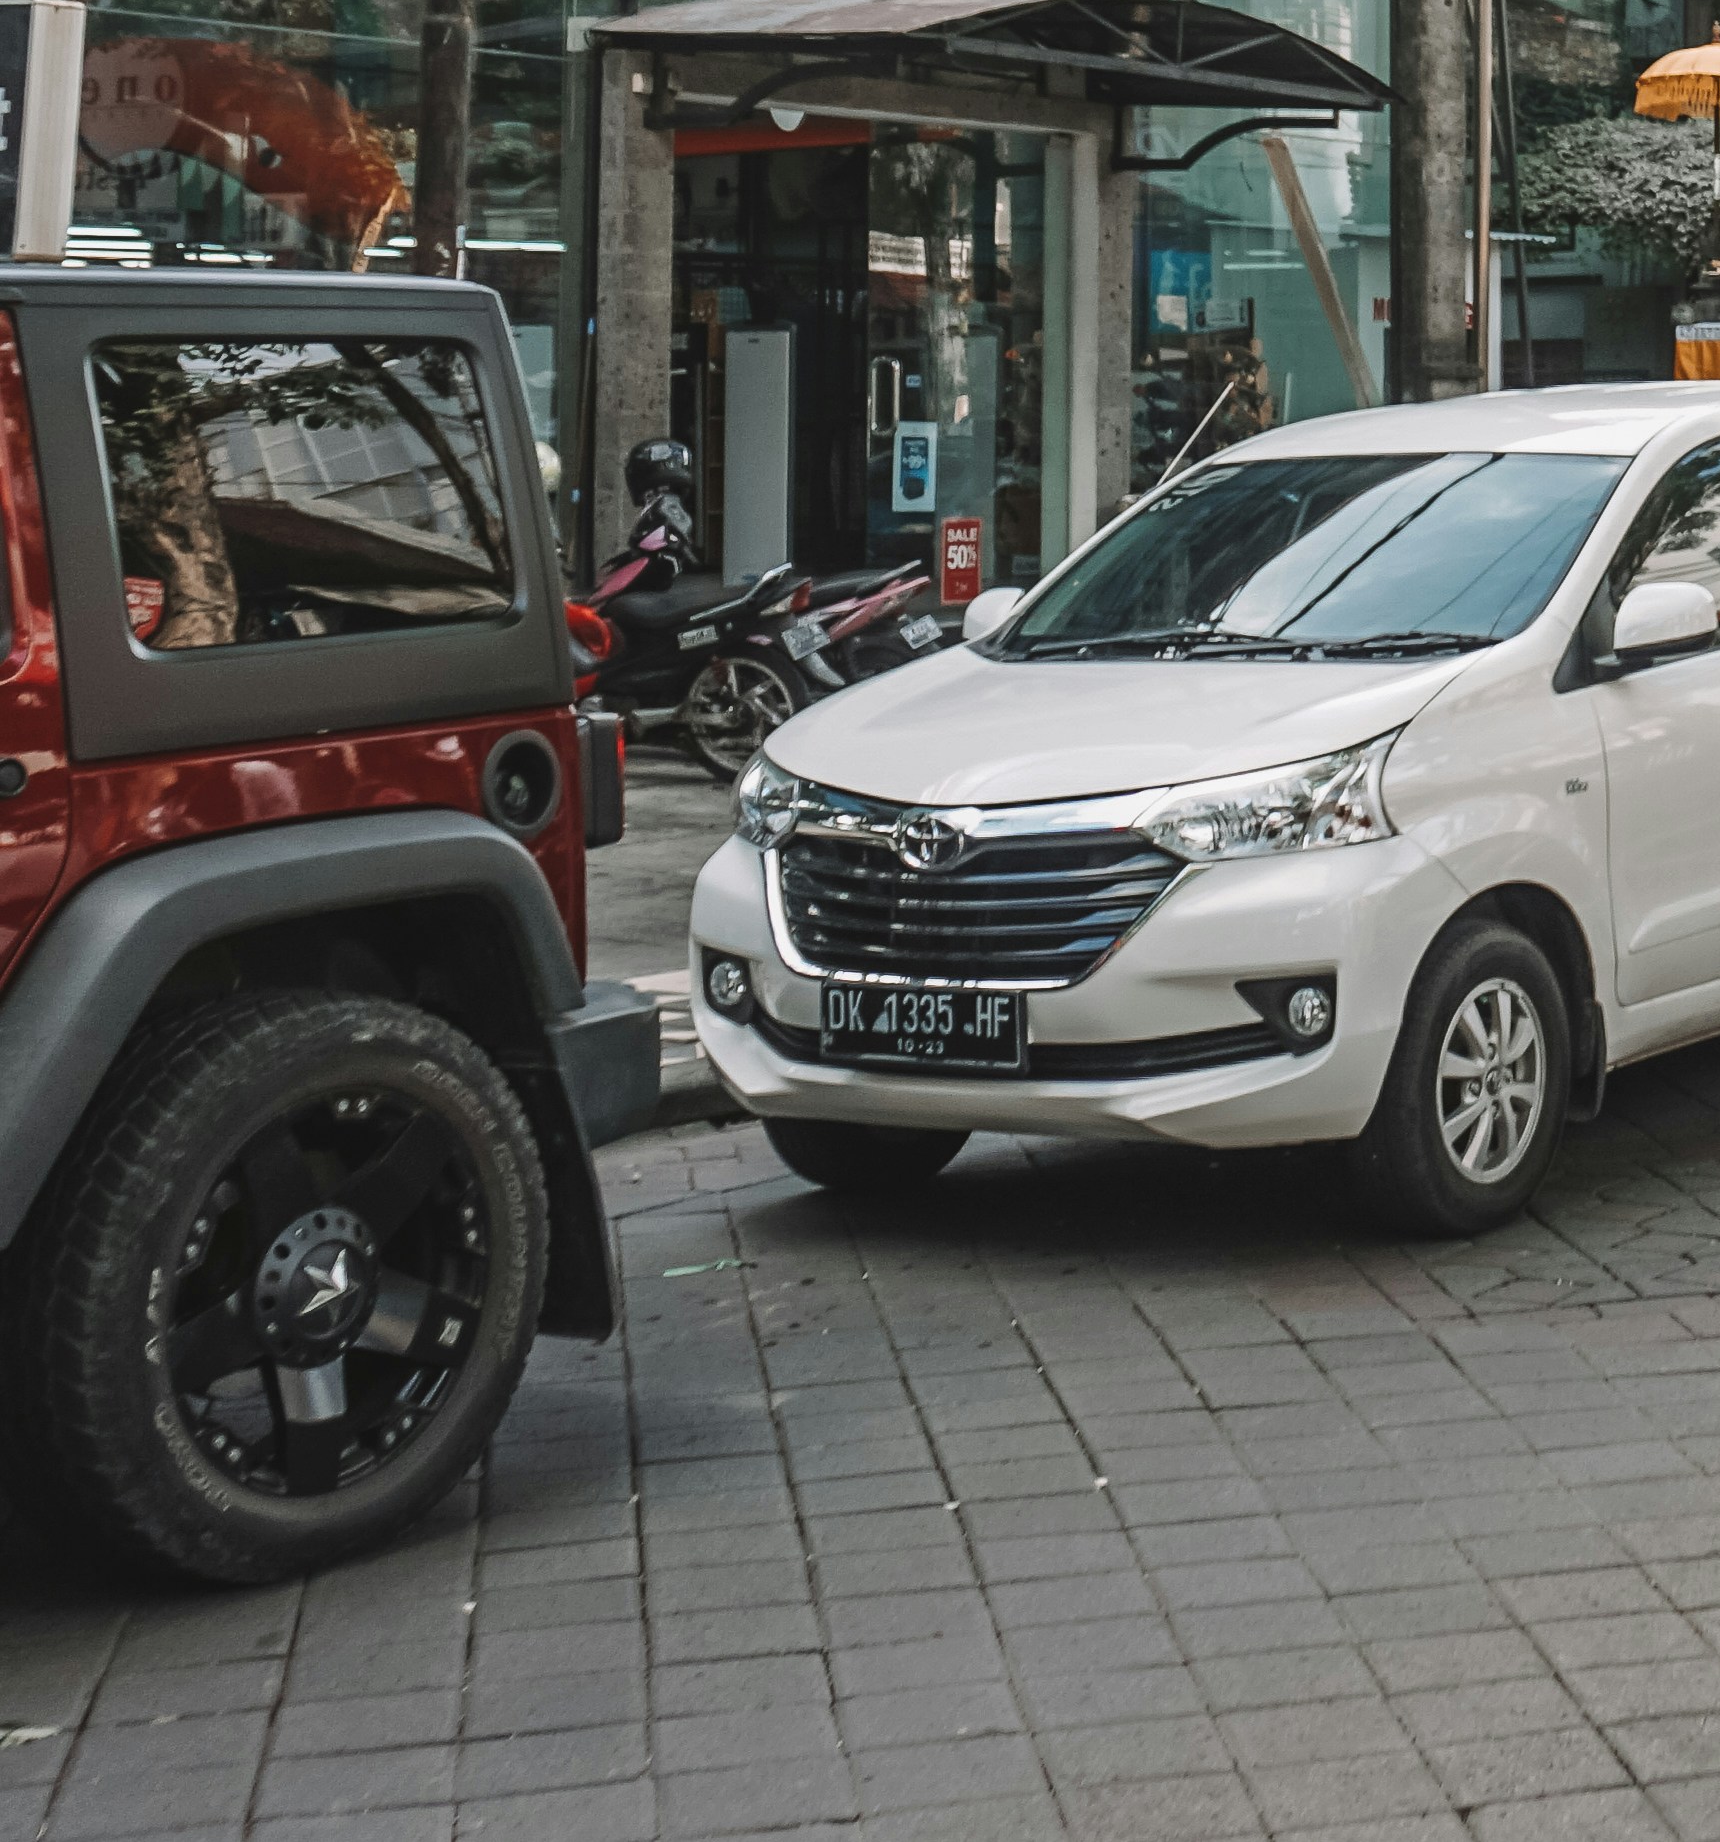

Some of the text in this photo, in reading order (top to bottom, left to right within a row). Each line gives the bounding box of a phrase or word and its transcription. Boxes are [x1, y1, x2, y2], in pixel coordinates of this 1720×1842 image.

[947, 527, 978, 543] SALE
[828, 989, 865, 1032] DK
[975, 994, 1010, 1038] HF
